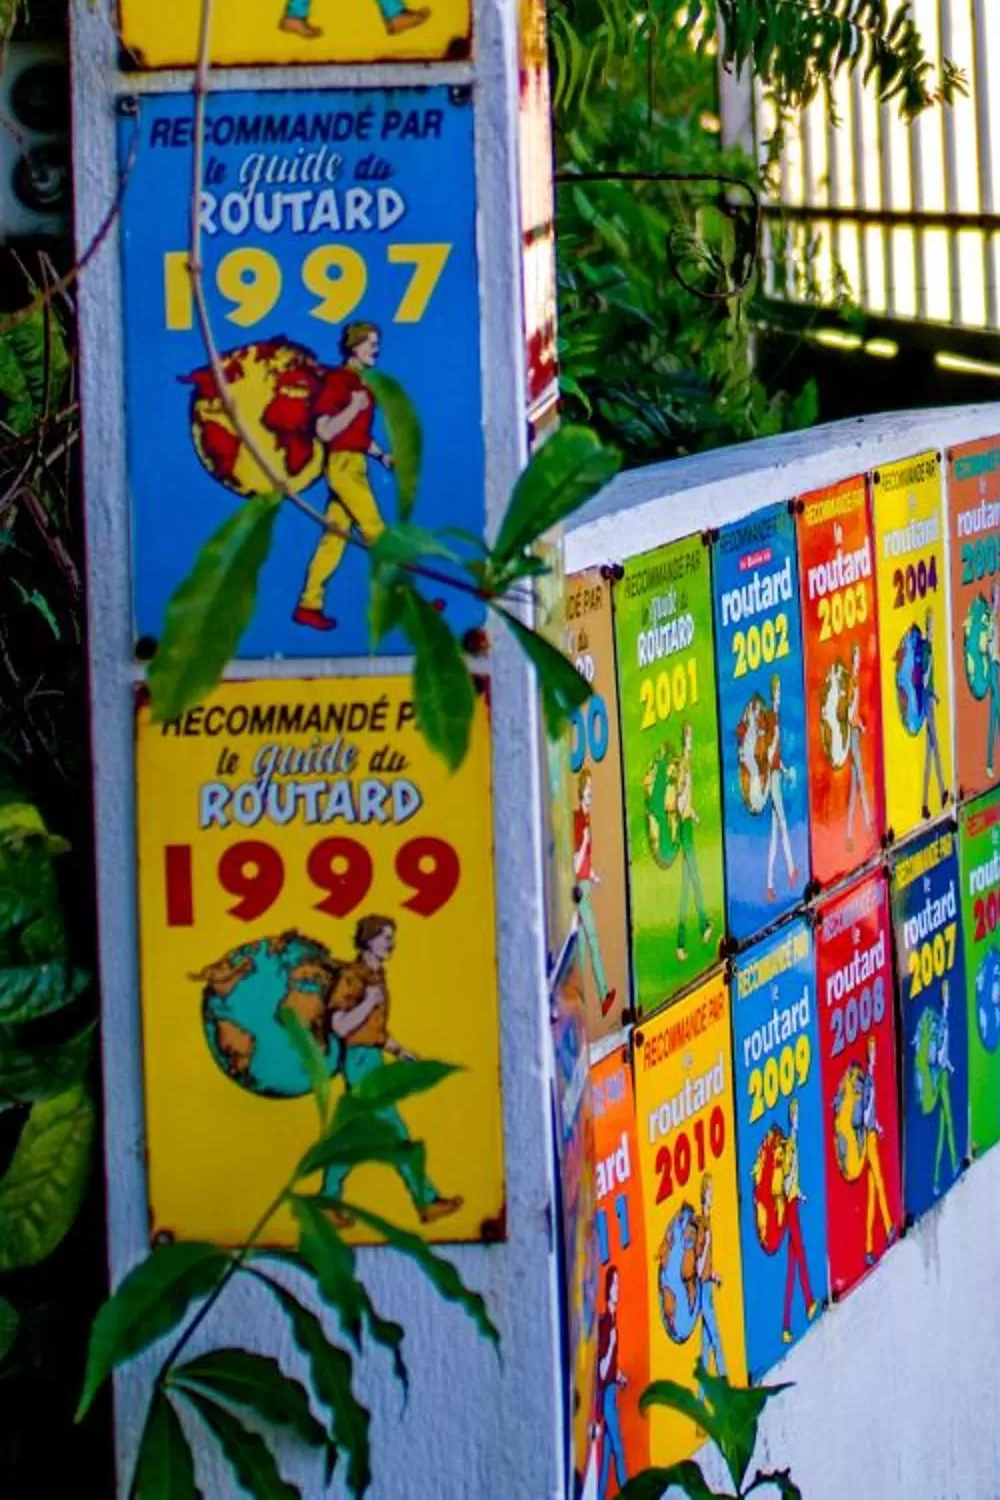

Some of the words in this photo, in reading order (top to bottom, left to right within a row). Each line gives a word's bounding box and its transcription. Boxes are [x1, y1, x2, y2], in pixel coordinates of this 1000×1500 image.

[380, 109, 444, 139] PAR
[205, 156, 226, 185] le
[239, 145, 343, 202] guide
[354, 153, 392, 181] du
[195, 186, 406, 235] ROUTARD
[163, 242, 453, 331] 1997
[721, 556, 792, 627] routard
[808, 538, 871, 600] routard
[893, 555, 937, 609] 2004
[637, 612, 695, 668] ROUTARD
[733, 613, 790, 679] 2002
[818, 583, 868, 642] 2003
[640, 658, 698, 731] 2001
[216, 746, 238, 775] le
[253, 736, 358, 791] guide
[369, 744, 409, 772] du
[199, 778, 424, 830] ROUTARD
[164, 835, 461, 927] 1999
[903, 879, 956, 949] routard
[826, 930, 885, 1006] routard
[908, 922, 957, 999] 2007
[743, 985, 810, 1067] routard
[830, 976, 886, 1059] 2008
[648, 1052, 724, 1145] routard
[748, 1033, 811, 1125] 2009
[655, 1105, 726, 1206] 2010
